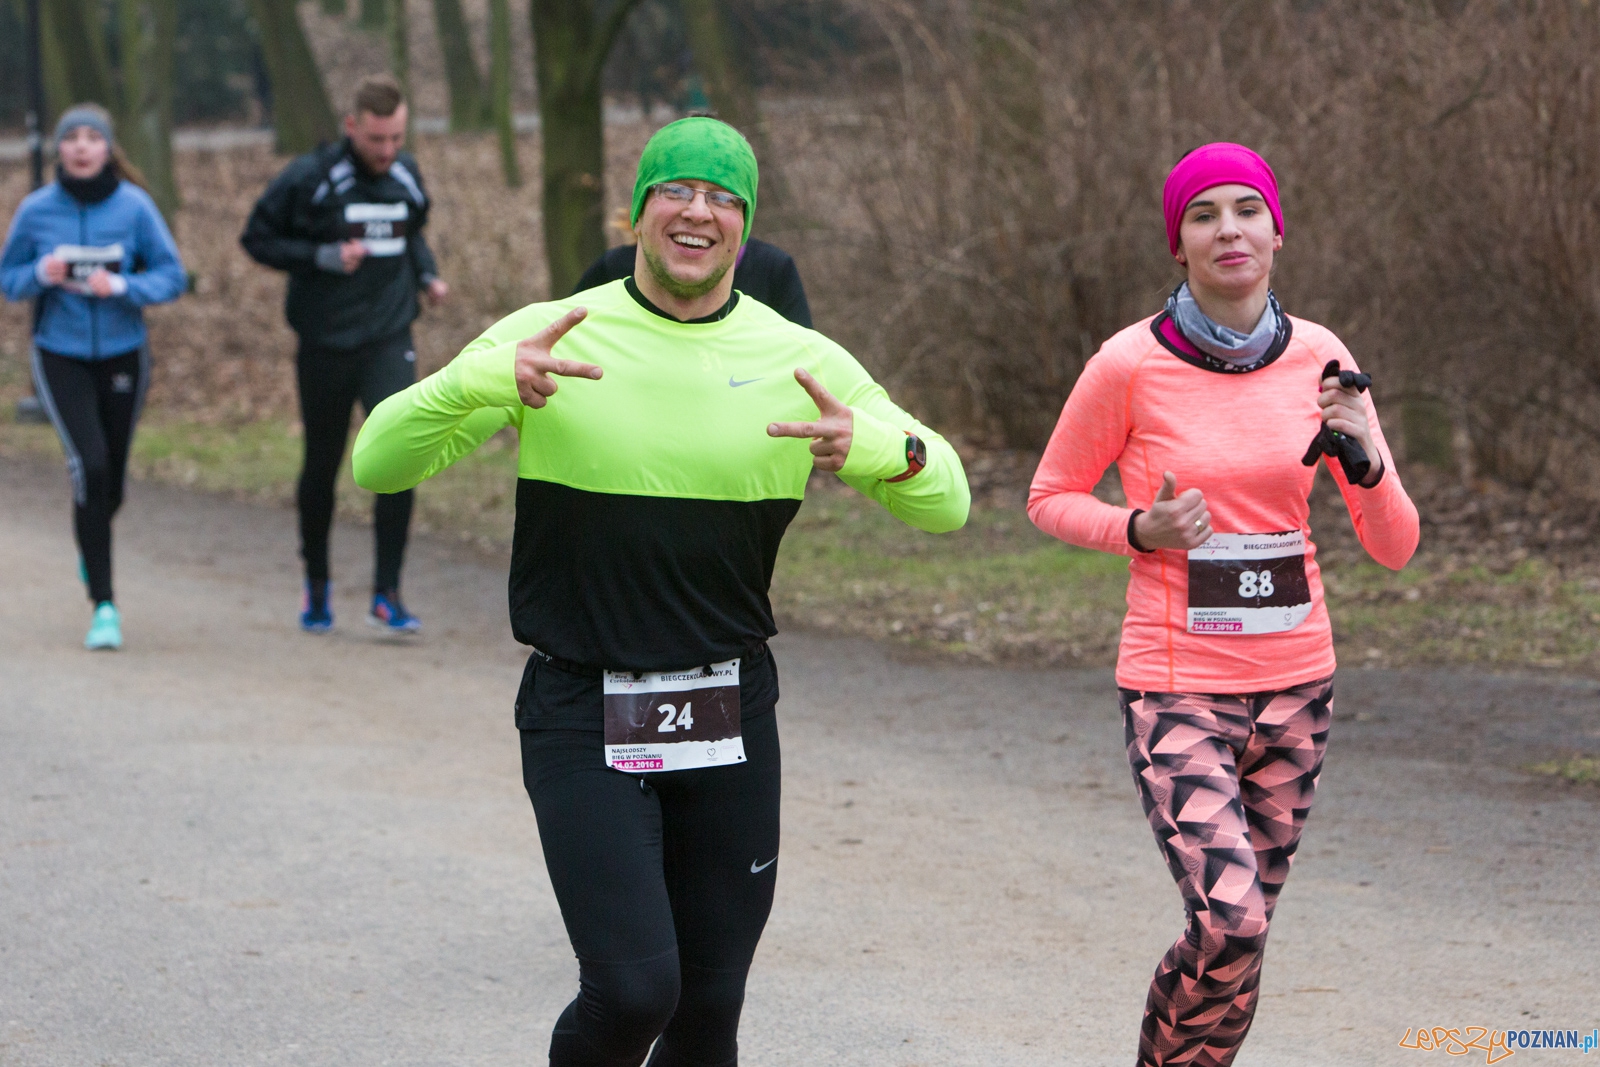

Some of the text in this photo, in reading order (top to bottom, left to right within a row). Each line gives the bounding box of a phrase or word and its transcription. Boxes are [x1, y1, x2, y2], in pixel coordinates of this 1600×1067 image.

[1238, 570, 1275, 598] 88
[1194, 623, 1233, 631] 14.02.2016
[657, 702, 693, 732] 24
